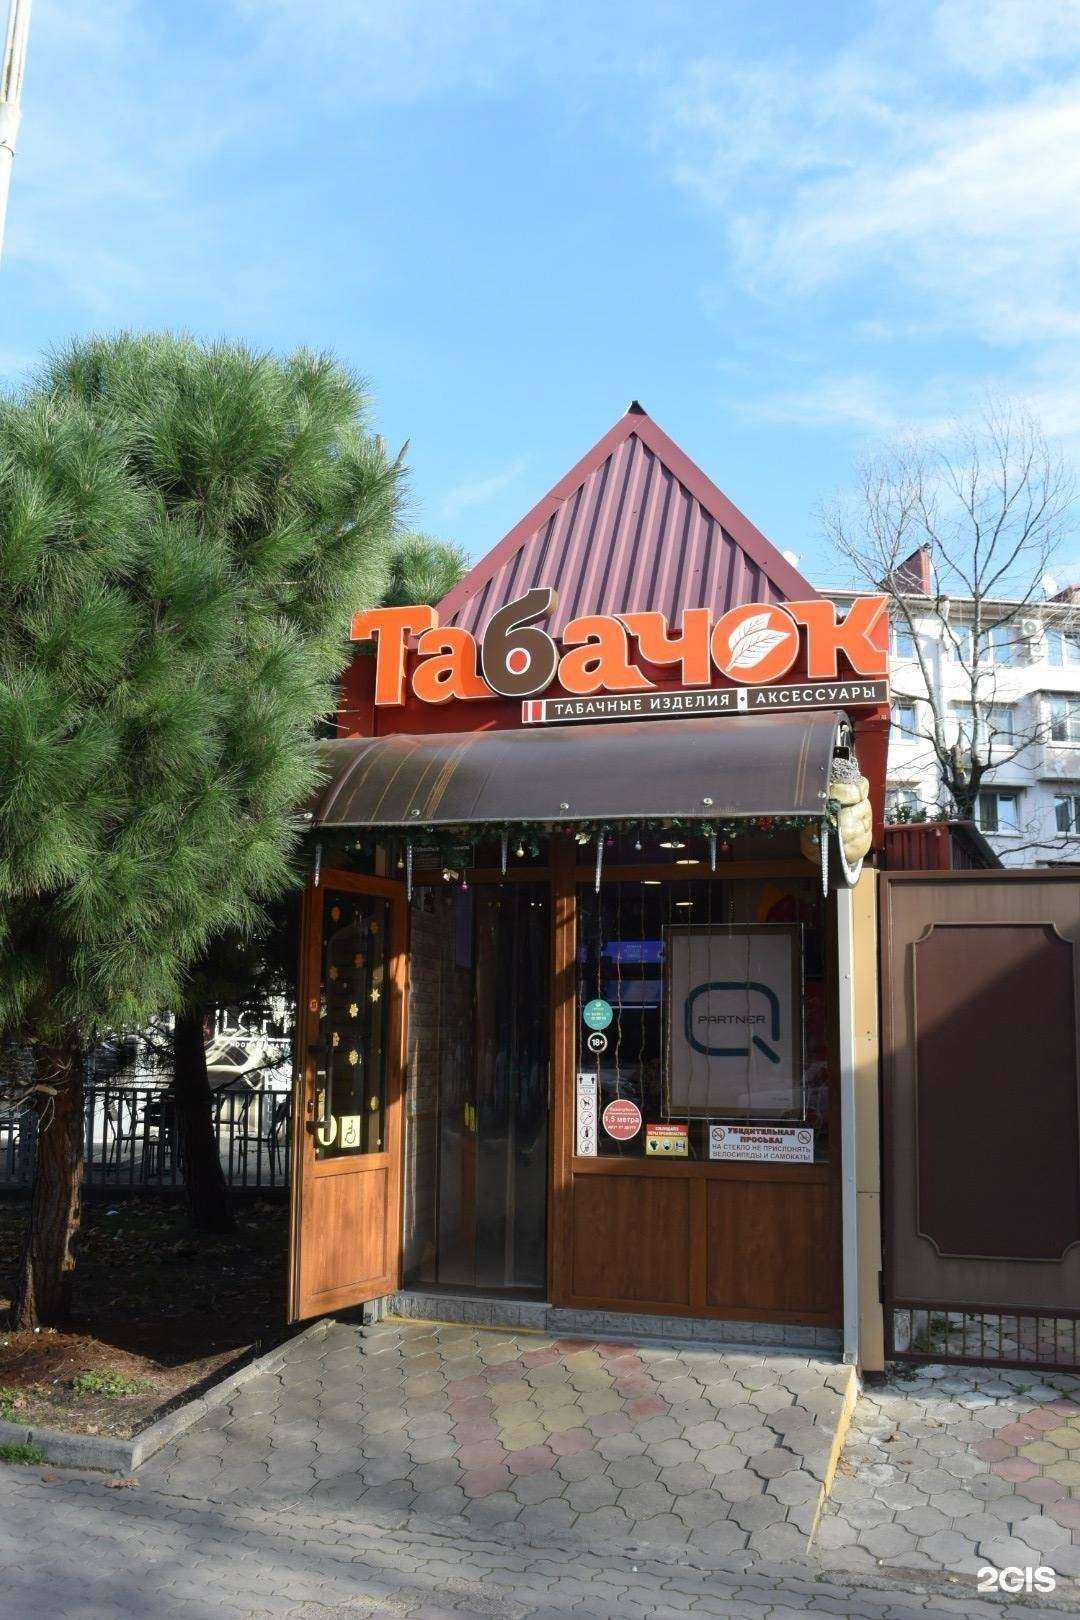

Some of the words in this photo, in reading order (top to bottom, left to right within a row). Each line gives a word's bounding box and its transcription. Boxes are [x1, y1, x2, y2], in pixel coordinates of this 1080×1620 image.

[350, 587, 890, 706] Табачок
[554, 699, 642, 715] ТАБАЧНЫЕ
[650, 694, 730, 710] ИЗДЕЛИЯ
[756, 686, 876, 704] АКСЕССУАРЫ
[697, 1015, 767, 1025] PARTNER
[591, 1038, 604, 1047] 18+
